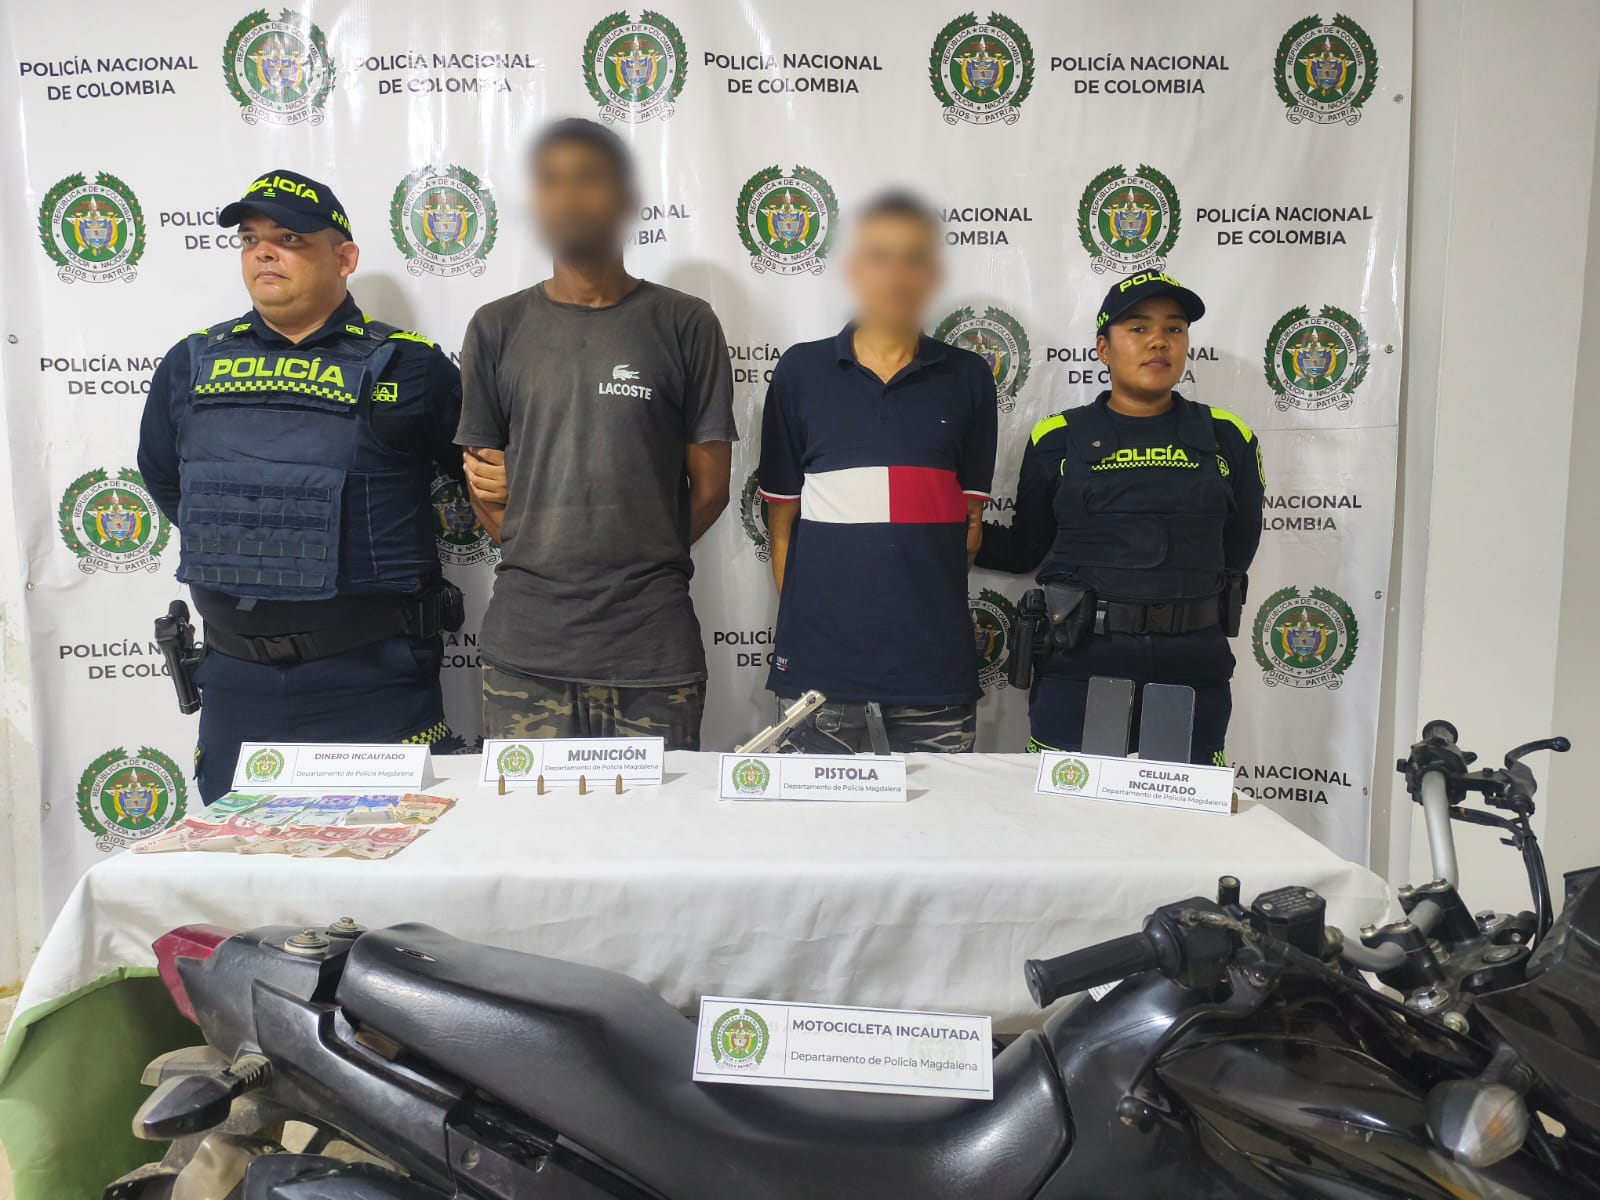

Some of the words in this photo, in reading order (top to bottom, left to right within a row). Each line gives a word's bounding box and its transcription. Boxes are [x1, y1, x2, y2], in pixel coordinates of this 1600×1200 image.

[997, 31, 1021, 65] COLOMBIA
[1341, 32, 1363, 66] COLOMBIA
[20, 56, 92, 76] POLICÍA
[98, 56, 198, 72] NACIONAL
[357, 51, 428, 71] OLICÍA
[432, 53, 536, 69] NACIONAL
[704, 52, 777, 71] POLICÍA
[784, 54, 882, 70] NACIONAL
[1051, 53, 1125, 71] POLICÍA
[1131, 56, 1229, 70] NACIONAL
[48, 85, 72, 100] DE
[77, 80, 175, 98] COLOMBIA
[379, 78, 403, 95] DE
[728, 79, 752, 93] DE
[758, 78, 859, 93] COLOMBIA
[1075, 80, 1099, 93] DE
[1105, 79, 1205, 93] COLOMBIA
[985, 90, 1014, 109] NACIONAL
[1328, 90, 1356, 108] NACIONAL
[950, 107, 970, 120] DIOS
[985, 107, 1014, 122] PATRIA
[1293, 107, 1314, 119] DIOS
[1328, 107, 1356, 122] PATRIA
[106, 190, 132, 223] COLOMBIA
[801, 183, 826, 216] COLOMBIA
[1144, 182, 1168, 216] COLOMBIA
[160, 207, 221, 227] POLICÍ
[641, 204, 691, 221] ONAL
[1197, 204, 1270, 223] POLICÍA
[1276, 206, 1372, 222] NACIONAL
[185, 235, 211, 250] DE
[945, 231, 1009, 246] OMBIA
[1218, 231, 1243, 245] DE
[1249, 230, 1346, 245] COLOMBIA
[101, 248, 129, 268] NACIONAL
[791, 241, 820, 261] NACIONAL
[1132, 241, 1161, 260] NACIONAL
[65, 266, 87, 280] DIOS
[102, 265, 132, 281] PATRIA
[758, 256, 777, 270] DIOS
[792, 257, 820, 273] PATRIA
[1097, 256, 1117, 270] DIOS
[1132, 256, 1161, 272] PATRIA
[993, 324, 1016, 356] COLOMBIA
[1329, 322, 1354, 353] COLOMBIA
[728, 343, 781, 361] OLICÍA
[40, 354, 122, 372] POLICÍA
[209, 357, 345, 388] POLICÍA
[734, 369, 759, 383] DE
[1068, 370, 1093, 384] DE
[68, 380, 97, 395] DE
[598, 382, 652, 400] LACOSTE
[1316, 378, 1346, 396] NACIONAL
[1281, 394, 1301, 406] DIOS
[1316, 393, 1346, 409] PATRIA
[129, 485, 157, 516] COLOMBIA
[1263, 495, 1362, 509] NACIONAL
[1263, 517, 1337, 531] LOMBIA
[123, 540, 152, 559] NACIONAL
[86, 557, 108, 568] DIOS
[125, 555, 154, 571] PATRIA
[1319, 603, 1345, 635] COLOMBIA
[714, 626, 776, 645] POLICÍ
[60, 639, 144, 659] POLICÍA
[737, 653, 762, 667] DE
[1305, 658, 1336, 675] NACIONAL
[88, 665, 117, 680] DE
[1270, 671, 1289, 682] DIOS
[1305, 672, 1336, 686] PATRIA
[568, 746, 646, 761] MUNICIÓN
[815, 767, 878, 780] PISTOLA
[1139, 770, 1189, 782] CELULAR
[1254, 765, 1352, 787] NACIONAL
[1102, 787, 1151, 798] Departamento
[1188, 797, 1228, 807] Magdalena
[1129, 781, 1196, 795] INCAUTADO
[1235, 786, 1329, 805] OLOMBIA
[792, 1020, 892, 1036] MOTOCICLETA
[896, 1026, 980, 1041] INCAUTADA
[791, 1051, 866, 1064] Departamento
[868, 1056, 881, 1065] de
[885, 1056, 917, 1067] Policía
[920, 1059, 977, 1071] Magdalena
